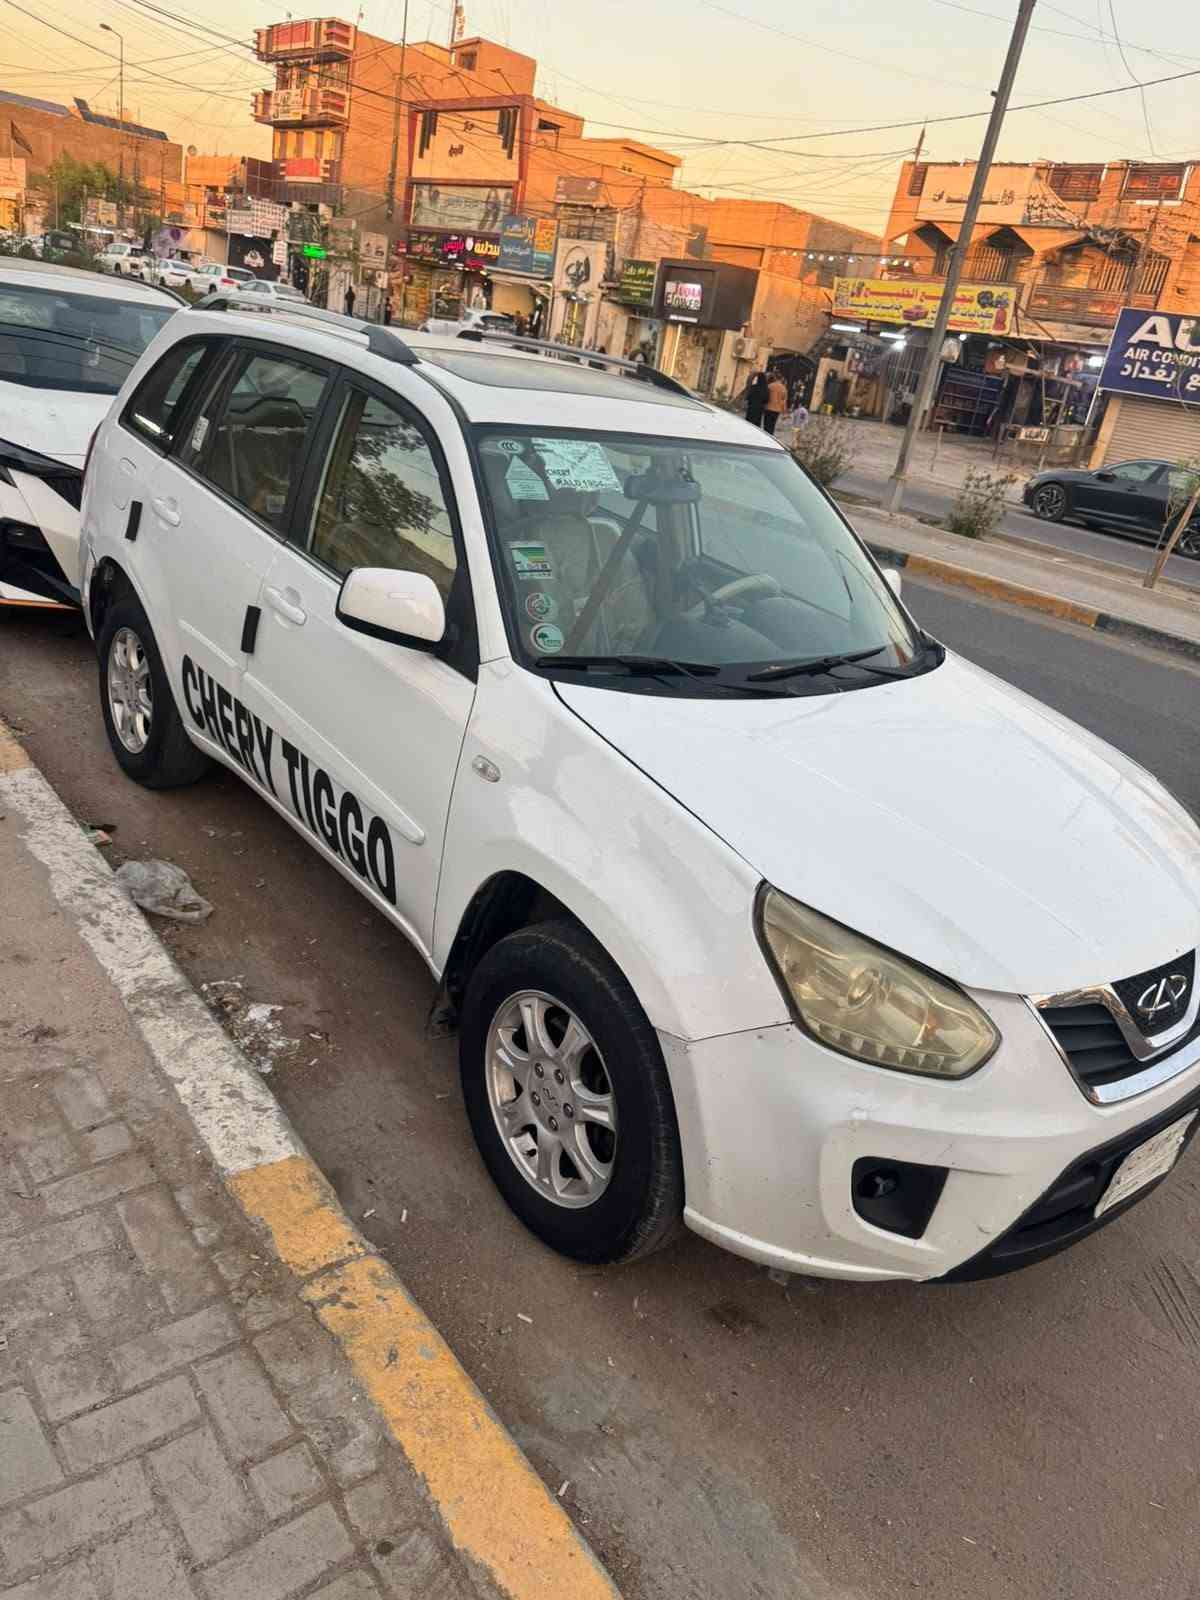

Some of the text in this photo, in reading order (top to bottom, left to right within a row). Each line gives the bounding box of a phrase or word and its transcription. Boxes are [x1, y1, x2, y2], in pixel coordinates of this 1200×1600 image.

[1123, 346, 1150, 361] AIR
[1120, 361, 1177, 388] بغداد
[182, 654, 397, 905] CHERY TIGGO
